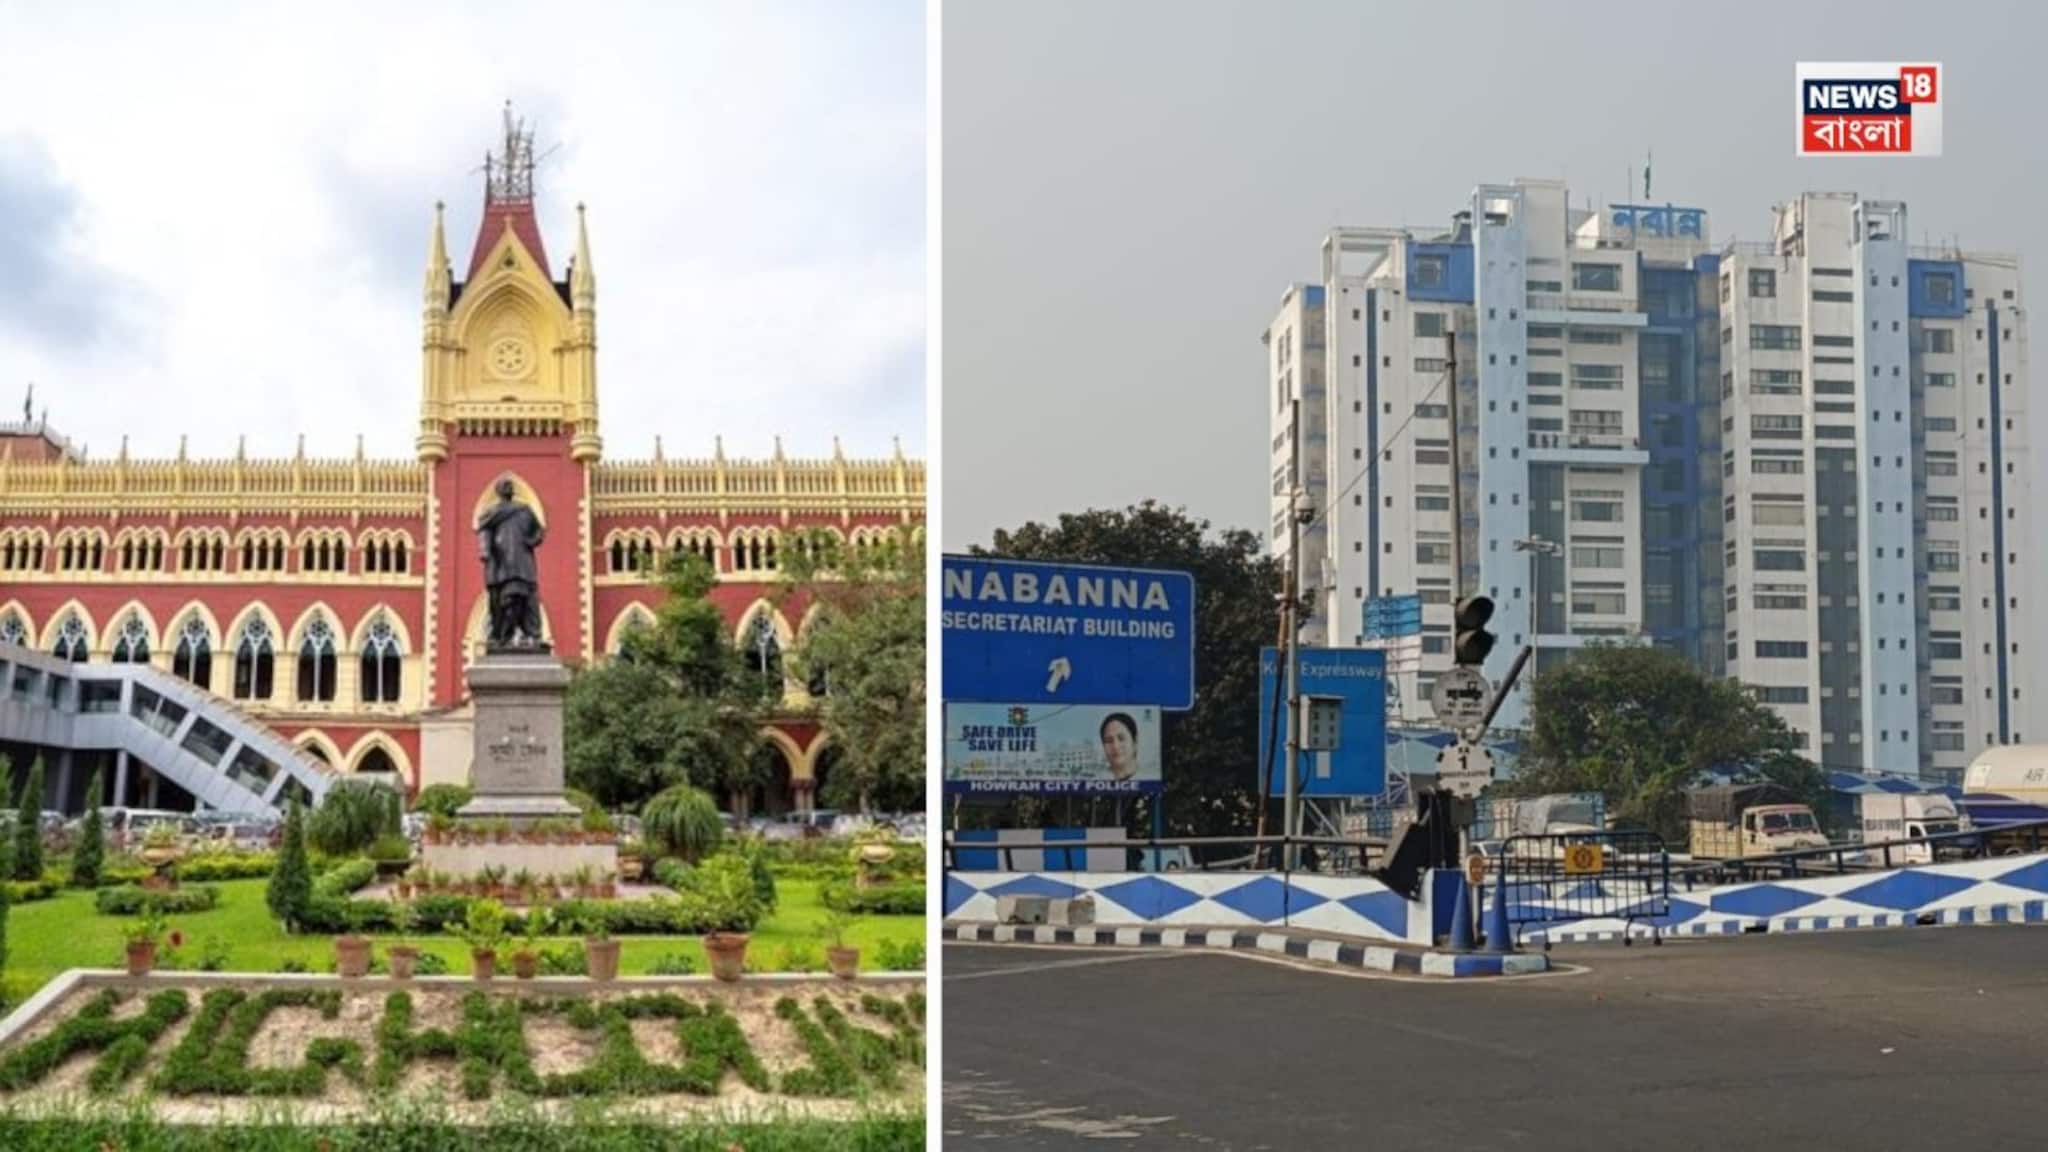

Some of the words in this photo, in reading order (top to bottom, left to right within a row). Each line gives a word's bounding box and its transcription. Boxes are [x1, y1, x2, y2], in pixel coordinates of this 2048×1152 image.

[1608, 203, 1706, 239] নবান্ন
[943, 568, 1170, 611] NABANNA
[942, 611, 1077, 634] SECRETARIAT
[1083, 618, 1175, 639] BUILDING
[1302, 662, 1381, 680] Expressway
[963, 725, 993, 738] SAFE
[997, 726, 1037, 738] DRIVE
[969, 739, 1005, 751] SAVE
[1009, 740, 1037, 751] LIFE
[970, 781, 1041, 791] HOWRAH
[1045, 781, 1081, 791] CITY
[1086, 781, 1140, 791] POLICE
